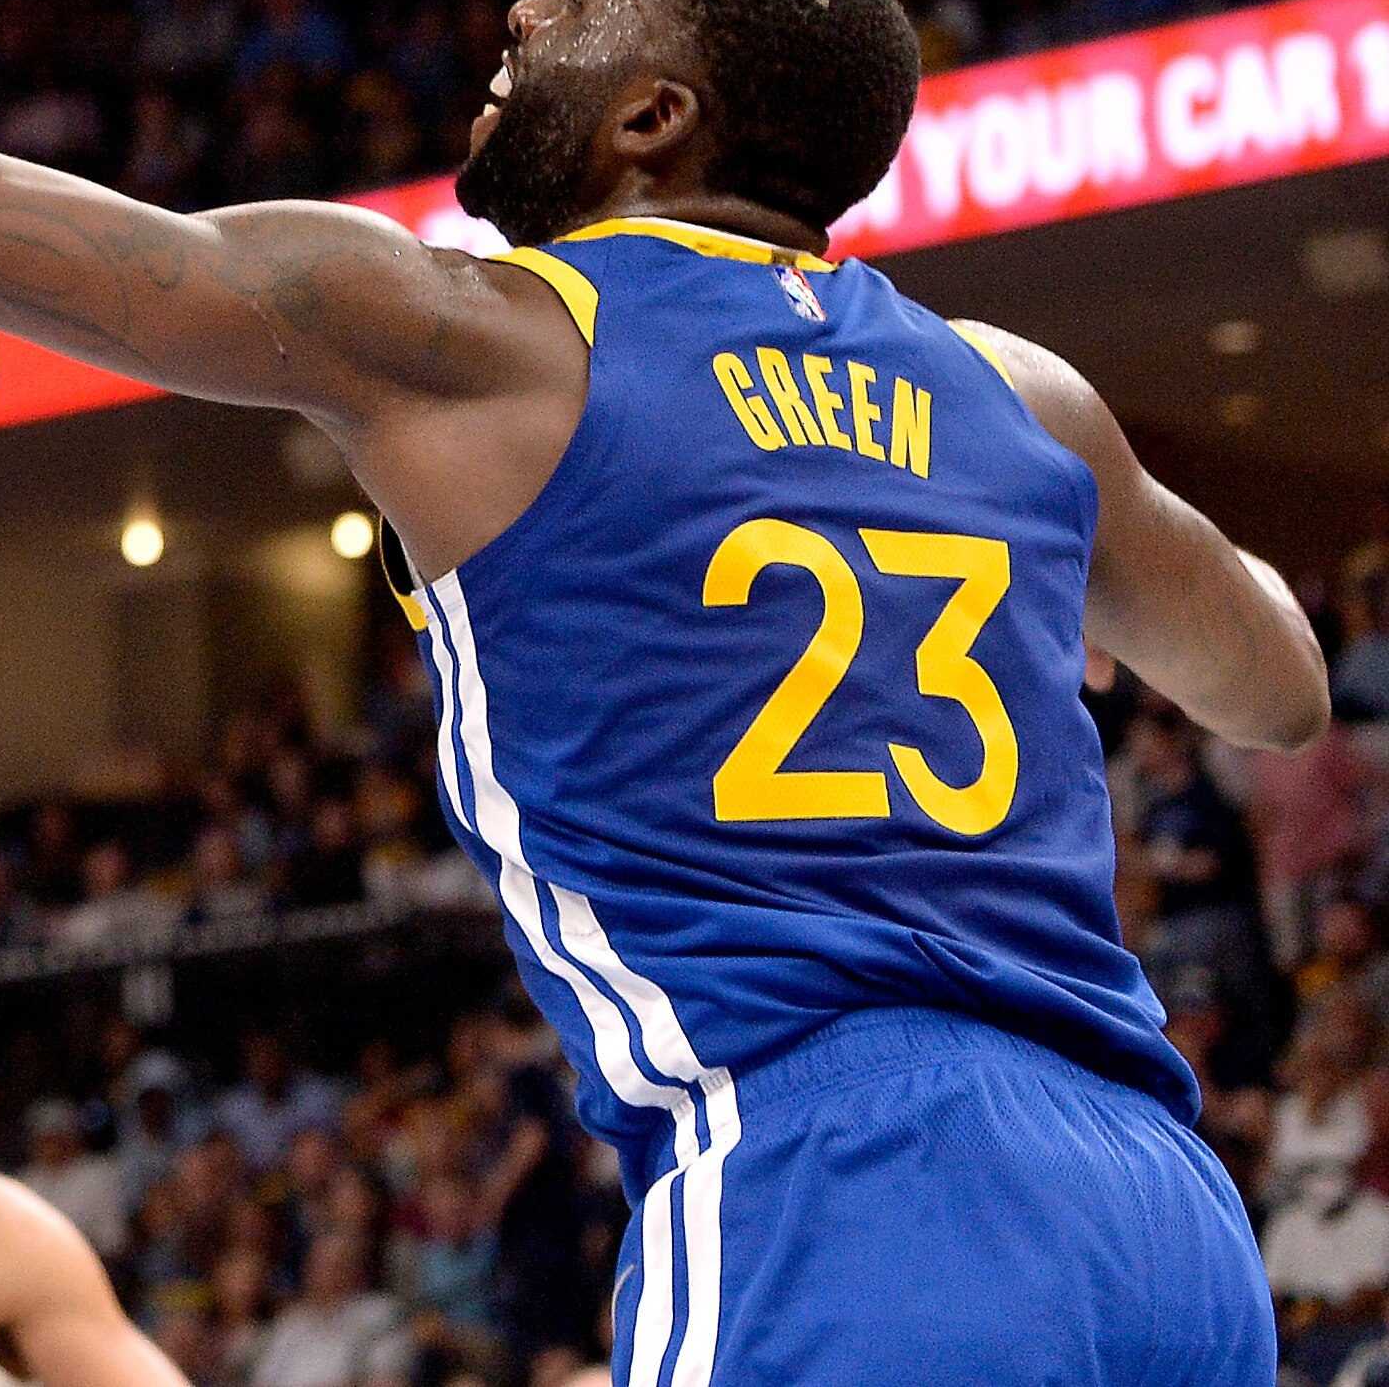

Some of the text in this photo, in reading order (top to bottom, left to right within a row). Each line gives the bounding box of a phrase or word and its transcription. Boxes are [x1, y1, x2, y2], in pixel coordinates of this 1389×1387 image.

[912, 71, 1147, 214] YOUR
[1156, 33, 1341, 169] CAR
[712, 347, 931, 479] GREEN
[702, 518, 1018, 835] 23
